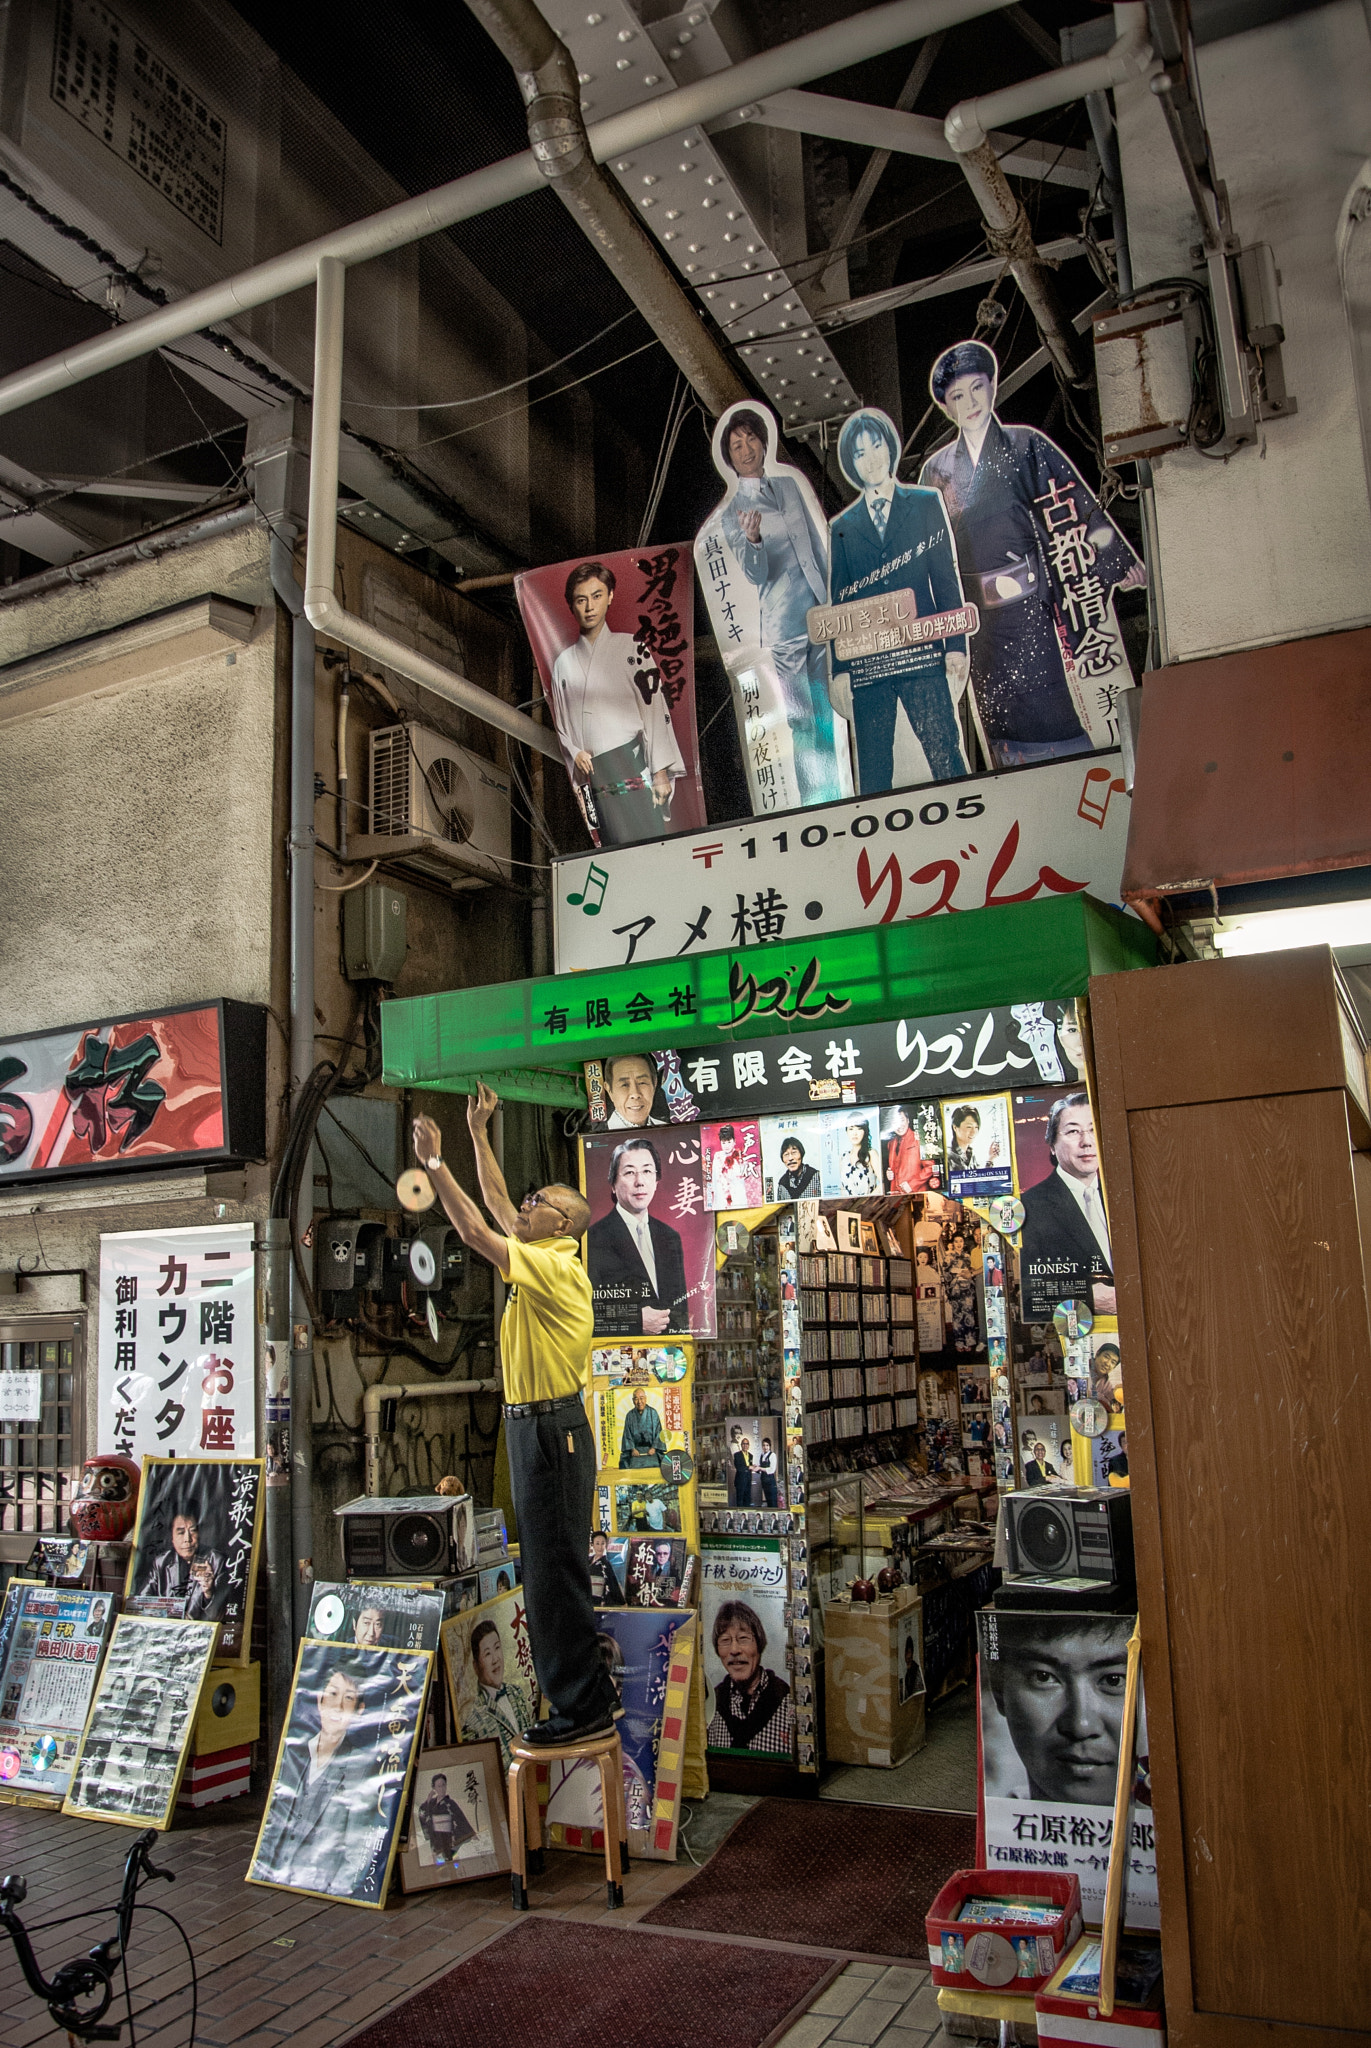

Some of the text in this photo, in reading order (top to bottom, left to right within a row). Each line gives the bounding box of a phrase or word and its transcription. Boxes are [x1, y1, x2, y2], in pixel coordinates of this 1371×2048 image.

[702, 536, 744, 643] 真田ナオキ
[1033, 478, 1122, 678] 古都情念
[633, 548, 688, 709] 男の絶唱
[816, 603, 911, 639] 氷川きよし
[874, 606, 974, 651] 「箱根八里の半次郎」
[741, 678, 778, 811] 別れの夜明け
[544, 985, 698, 1036] 有限会社
[587, 1064, 605, 1120] 北島三郎
[687, 1038, 864, 1095] 有限会社
[669, 1139, 704, 1219] 心妻
[739, 1124, 759, 1179] 一声一代
[155, 1255, 188, 1458] カウンタ
[225, 1470, 259, 1589] 演歌人生
[598, 1486, 610, 1532] 岡千秋
[633, 1542, 664, 1607] 船村徹
[702, 1564, 783, 1585] 千秋ものがたり
[37, 1639, 100, 1662] 隅田川慕情
[223, 1604, 239, 1645] 冠二郎
[988, 1614, 999, 1660] 石原裕次郎
[988, 1844, 1068, 1867] 「石原裕次郎
